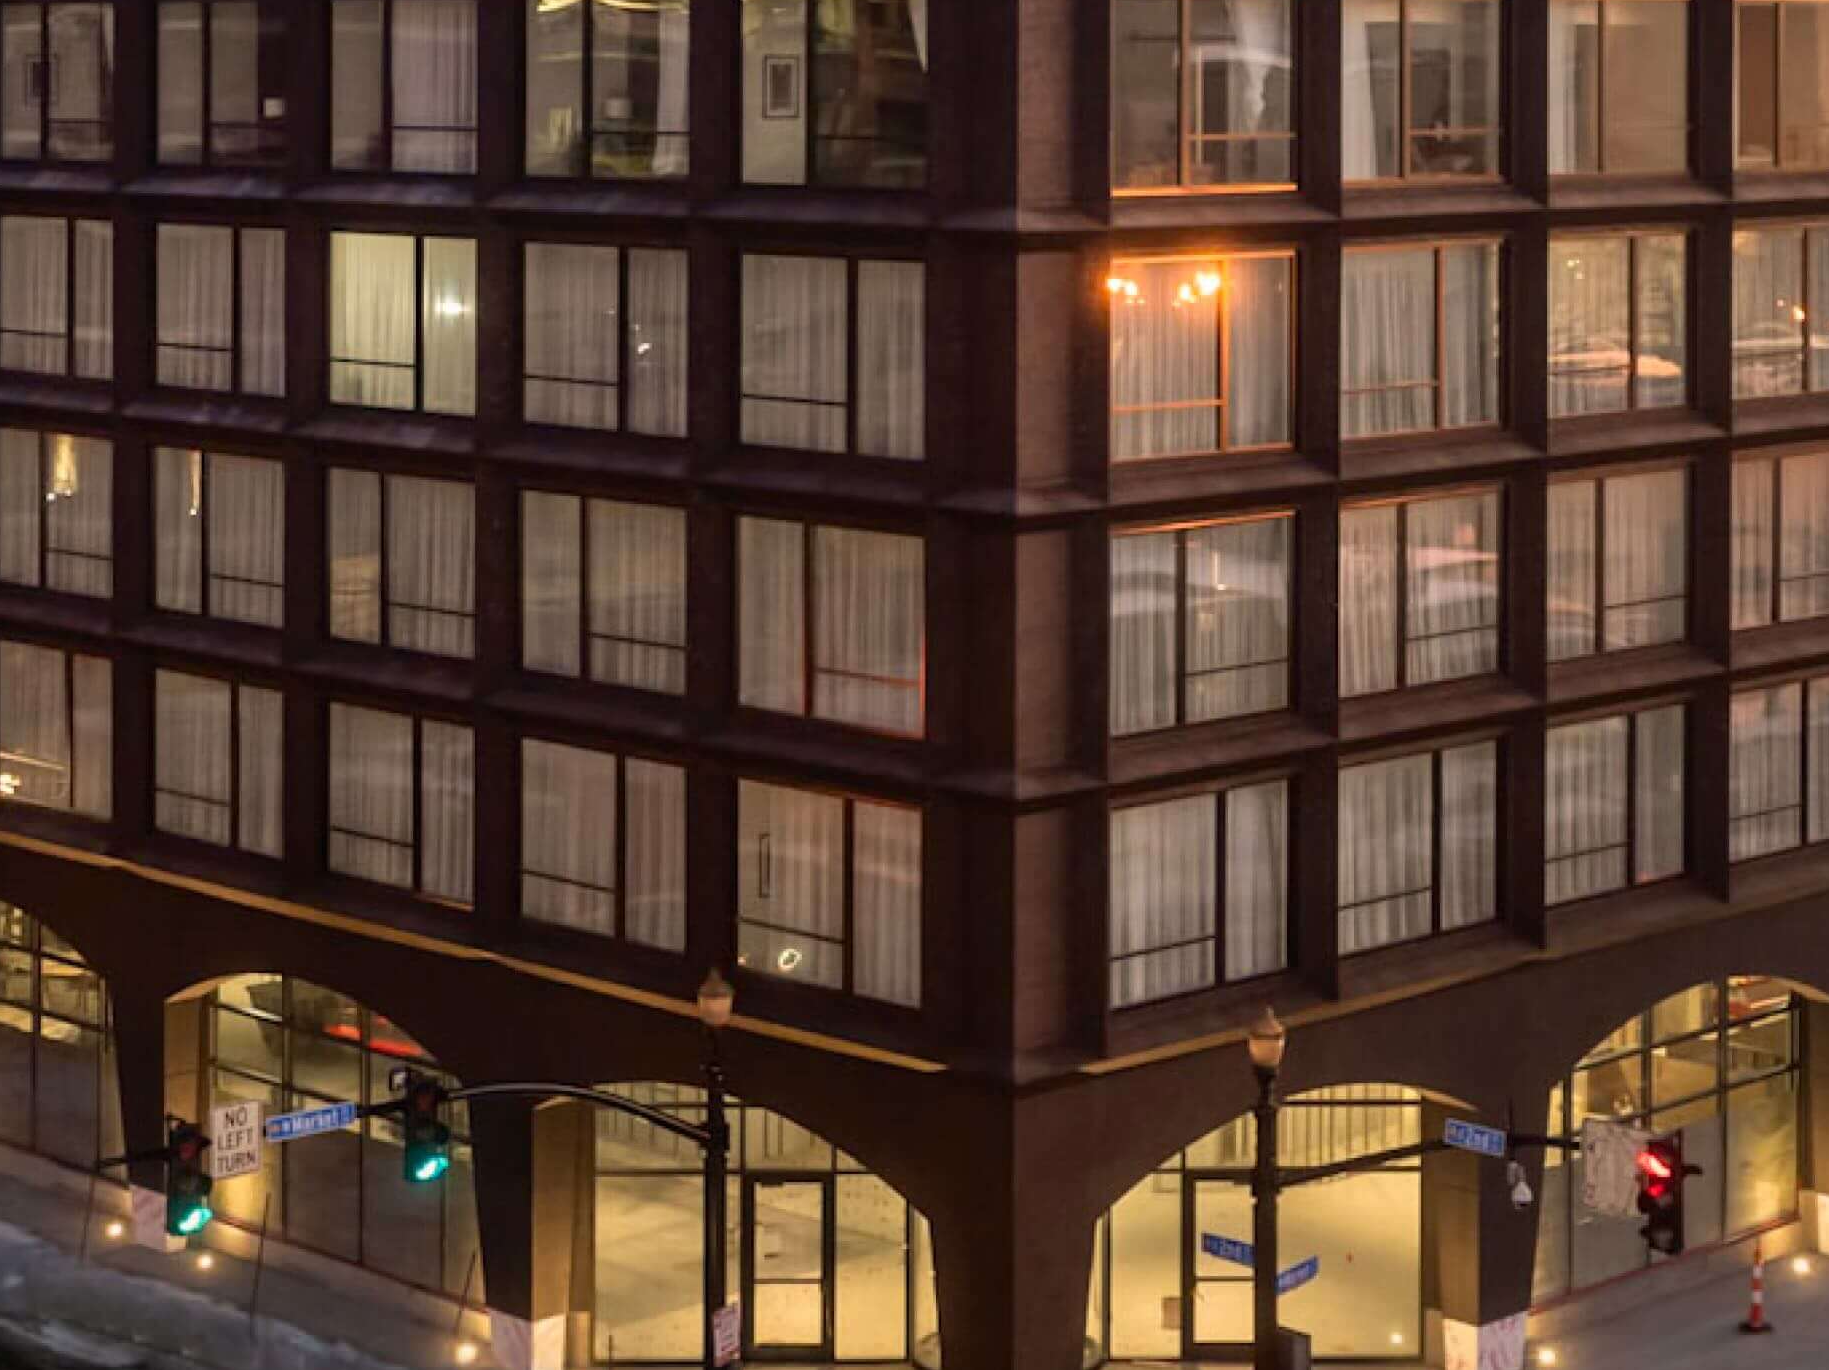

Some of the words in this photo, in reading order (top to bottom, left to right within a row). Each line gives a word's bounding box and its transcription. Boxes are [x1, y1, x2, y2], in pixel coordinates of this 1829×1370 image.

[224, 1105, 248, 1129] NO
[217, 1127, 253, 1151] LEFT
[217, 1150, 257, 1174] TURN
